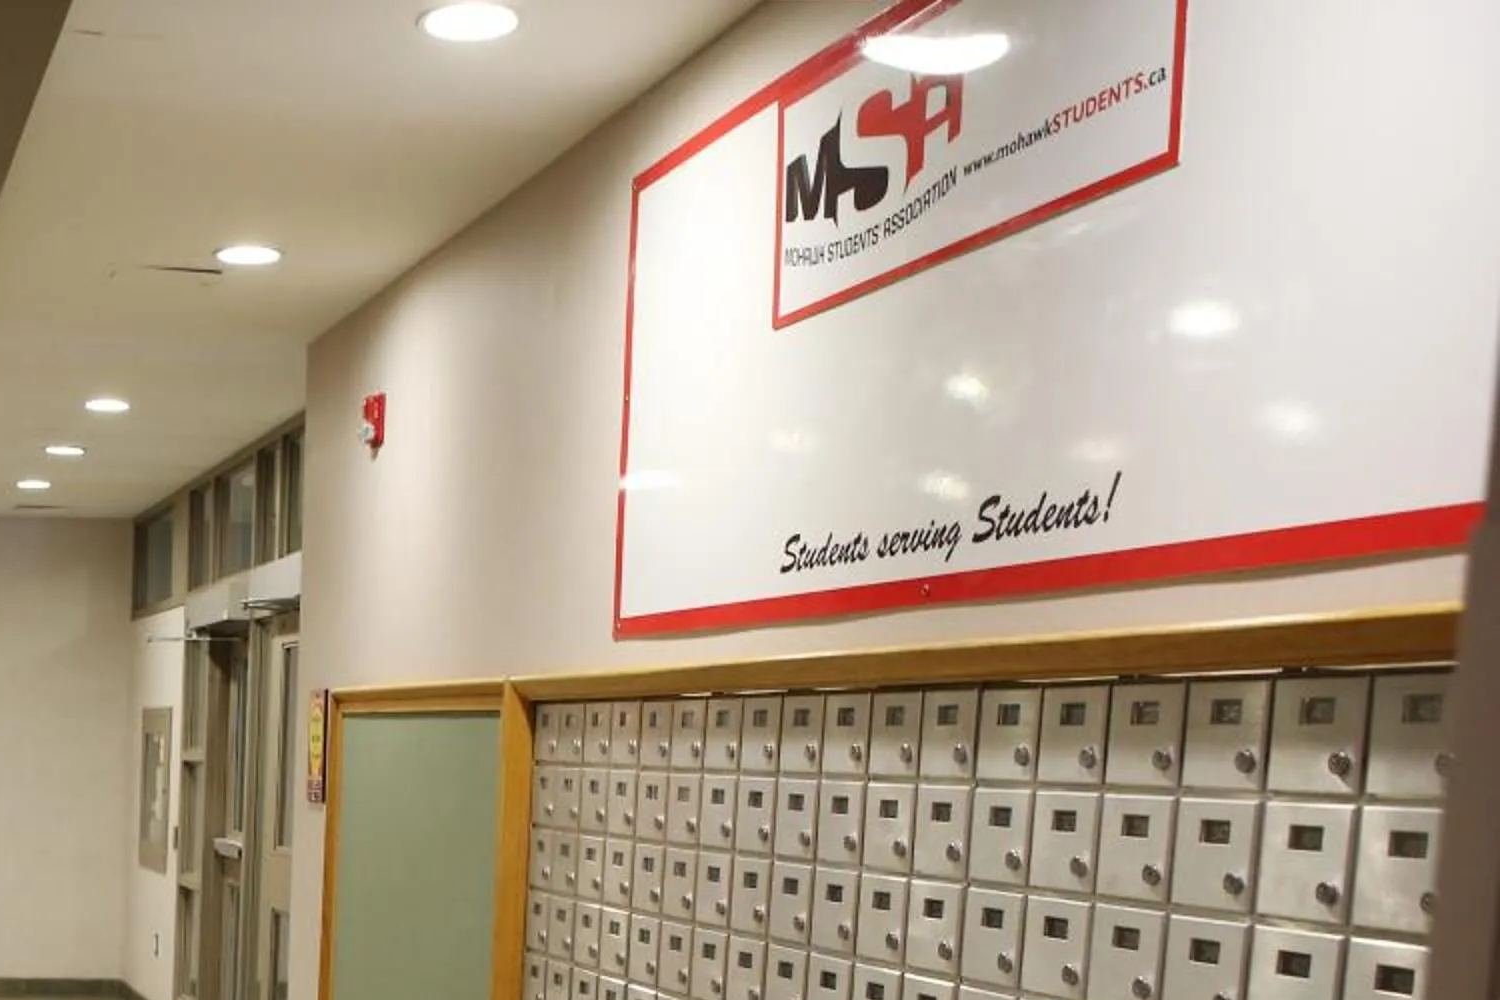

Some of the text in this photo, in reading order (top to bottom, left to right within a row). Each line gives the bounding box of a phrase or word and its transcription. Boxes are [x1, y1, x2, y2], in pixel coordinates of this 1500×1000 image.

[883, 166, 958, 239] ASSOCIATION
[963, 66, 1167, 176] www.mohawkSTUDENTS.ca
[780, 470, 1122, 574] Students serving Students!
